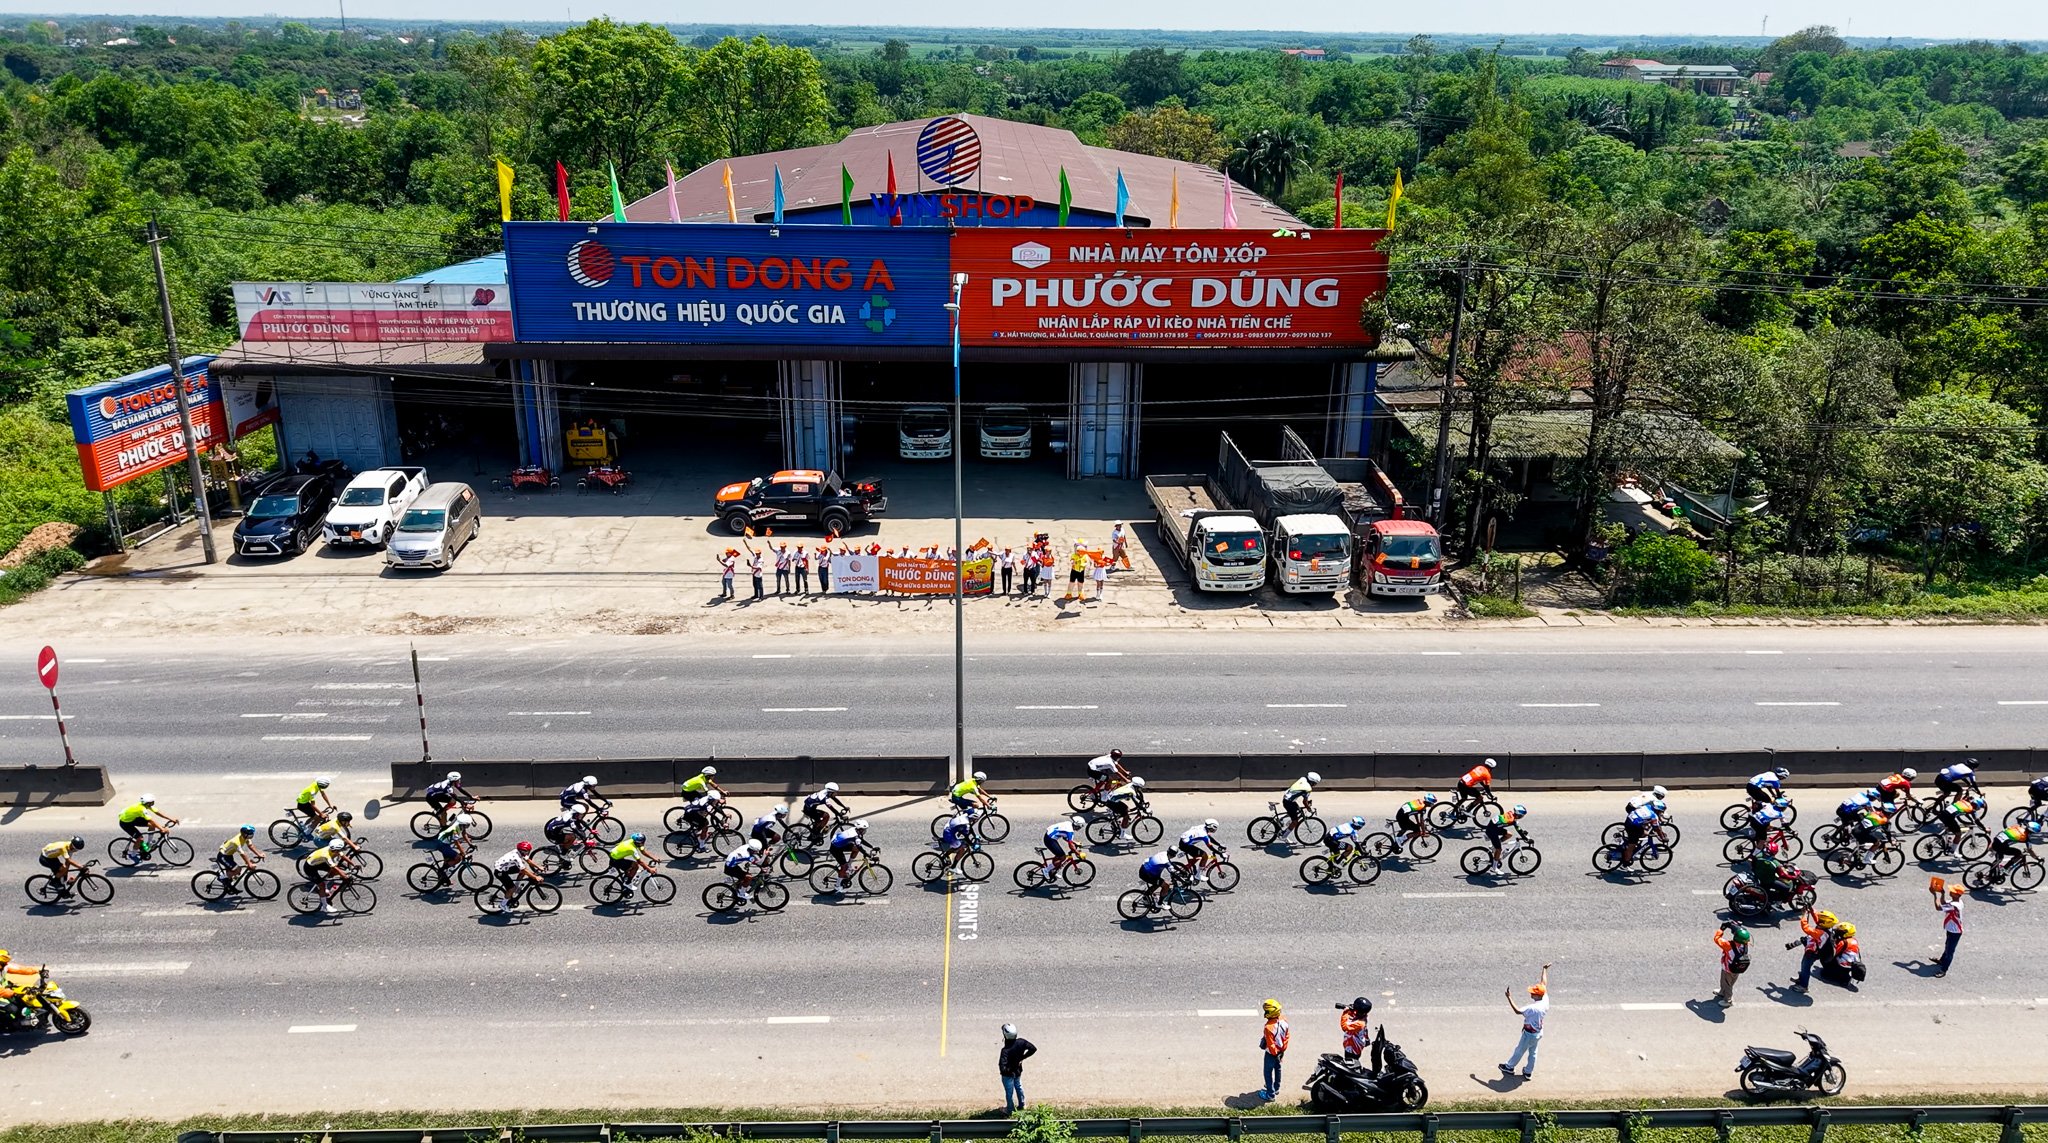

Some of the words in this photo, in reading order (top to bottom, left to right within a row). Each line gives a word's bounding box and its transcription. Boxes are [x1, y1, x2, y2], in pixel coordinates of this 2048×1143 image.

[869, 193, 1035, 218] WINSHOP
[1069, 242, 1116, 263] NHÀ
[1120, 242, 1168, 263] MÁY
[1172, 242, 1218, 263] TÔN
[1222, 242, 1267, 263] XỐP
[620, 256, 716, 289] TON
[726, 257, 853, 290] DONG
[862, 259, 896, 291] A
[992, 270, 1173, 308] PHƯỚC
[1190, 270, 1340, 308] DŨNG
[572, 299, 667, 322] THƯƠNG
[677, 299, 726, 327] HIỆU
[736, 300, 799, 326] QUỐC
[807, 304, 846, 324] GIA
[1038, 314, 1079, 331] NHẬN
[1082, 312, 1111, 329] LẮP
[1114, 314, 1142, 329] RÁP
[1146, 315, 1161, 329] VÌ
[1164, 314, 1193, 329] KÈO
[1197, 315, 1227, 329] NHÀ
[1230, 314, 1260, 329] TIỀN
[1264, 314, 1293, 329] CHẾ
[262, 321, 310, 334] PHƯỚC
[313, 322, 350, 334] DŨNG
[120, 391, 152, 413] TON
[153, 378, 194, 404] DOG
[197, 374, 209, 389] A
[117, 435, 168, 470] PHƯỚC
[885, 568, 922, 580] PHƯỚC
[925, 569, 955, 581] DŨNG
[958, 884, 980, 932] SPRINT
